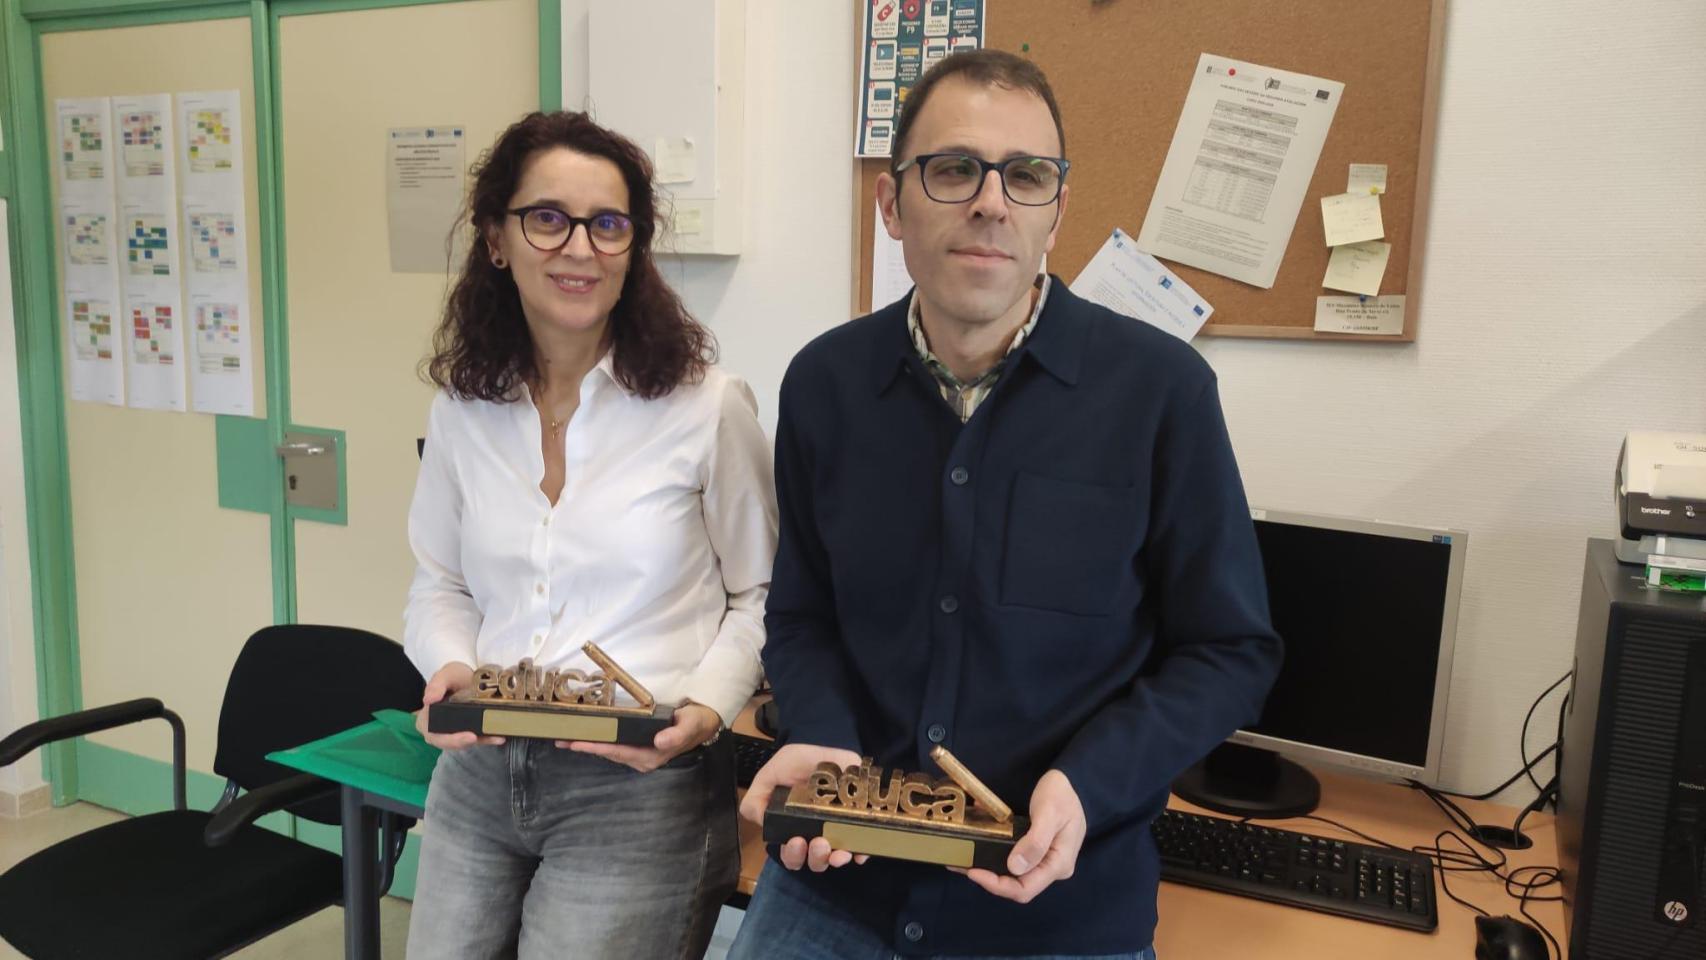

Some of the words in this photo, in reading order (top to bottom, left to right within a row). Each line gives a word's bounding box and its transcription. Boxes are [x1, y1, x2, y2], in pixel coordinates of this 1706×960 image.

[1641, 506, 1671, 515] brother
[473, 657, 616, 707] educa
[809, 757, 966, 824] educa
[1667, 902, 1685, 920] hp
